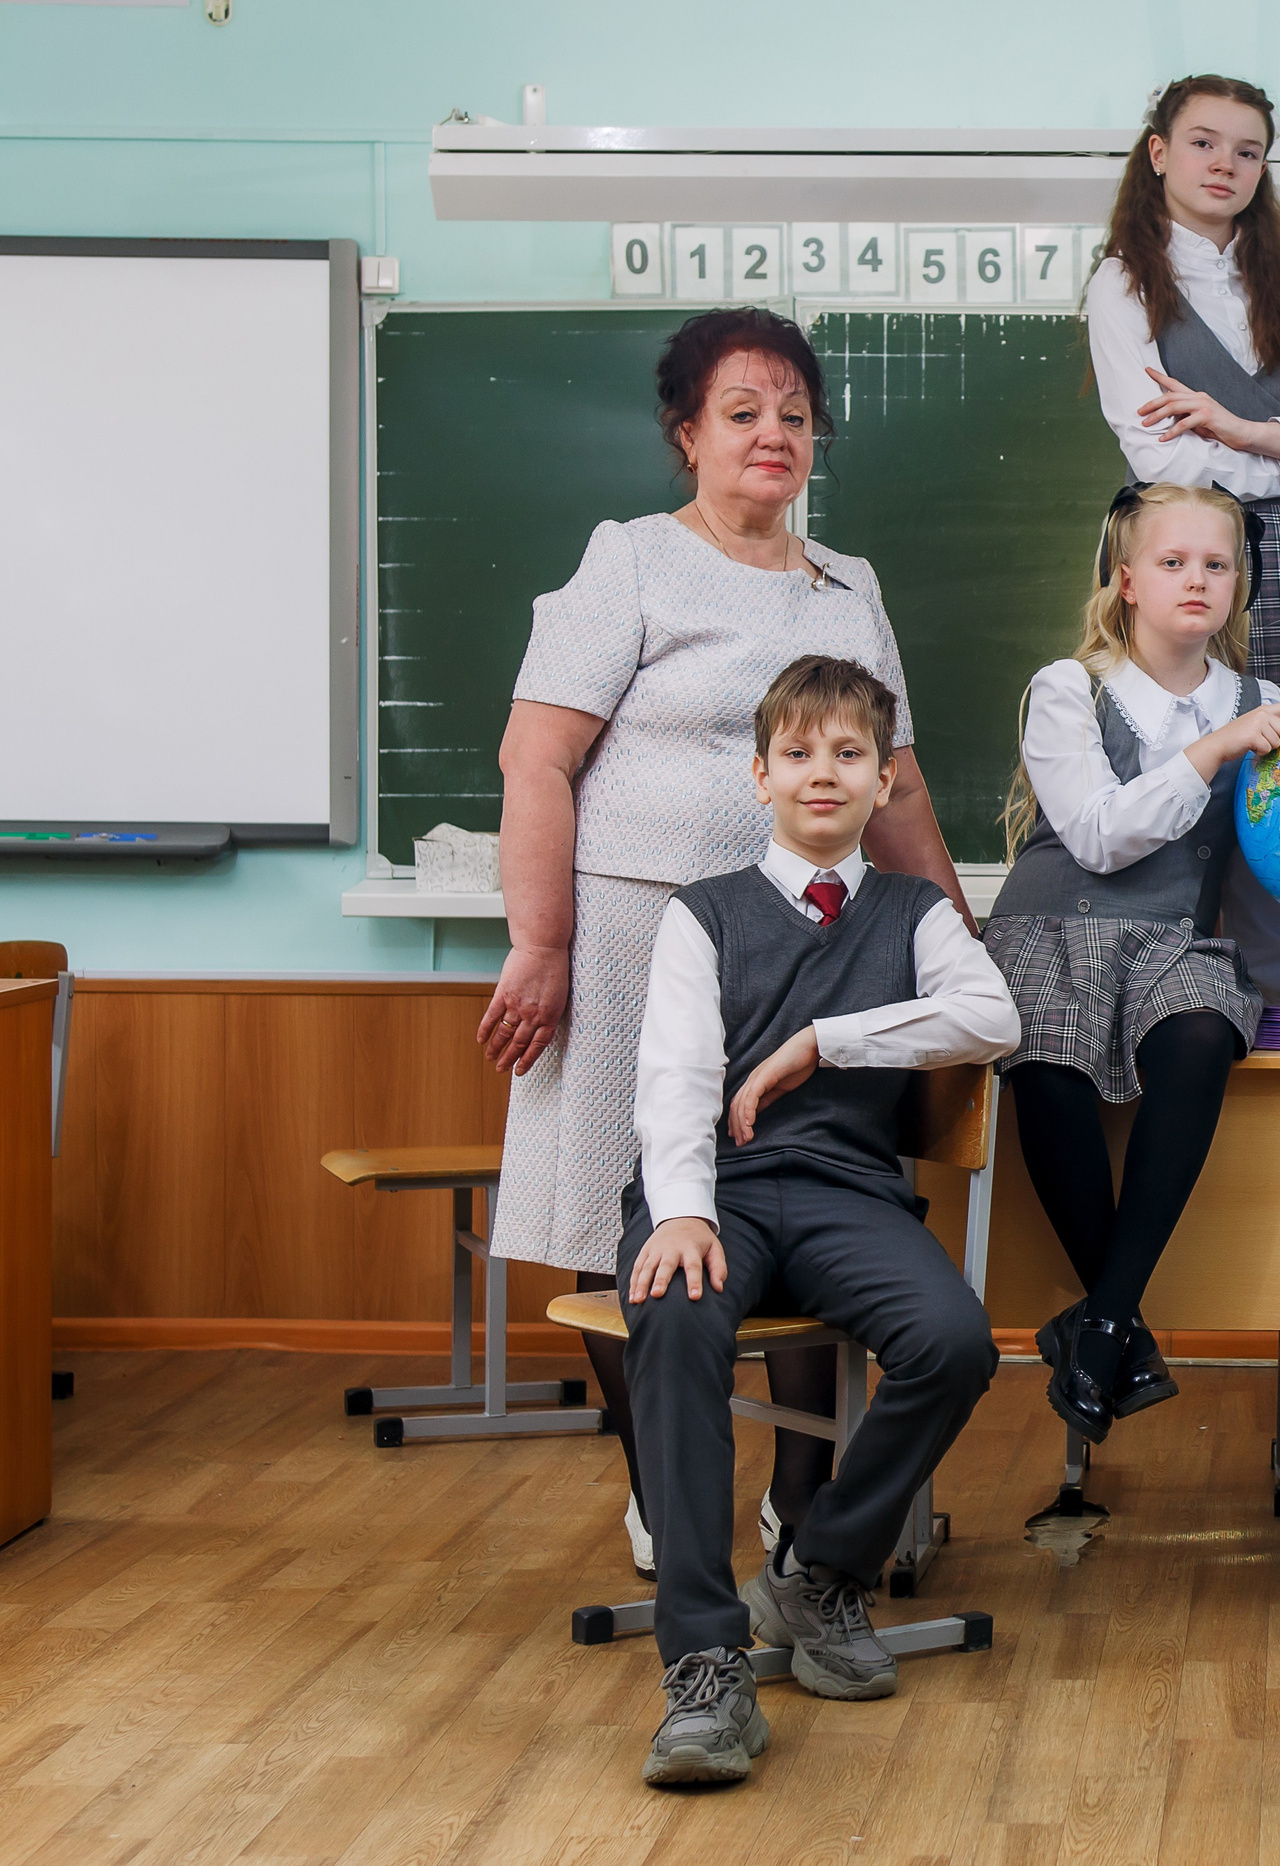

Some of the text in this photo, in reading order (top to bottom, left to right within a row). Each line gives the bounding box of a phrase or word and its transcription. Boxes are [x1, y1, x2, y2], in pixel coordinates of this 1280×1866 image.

[626, 239, 648, 274] 0
[690, 244, 706, 279] 1
[744, 245, 767, 279] 2
[803, 238, 825, 272] 3
[858, 237, 882, 272] 4
[923, 249, 945, 284] 5
[978, 248, 1001, 283] 6
[1036, 245, 1058, 280] 7
